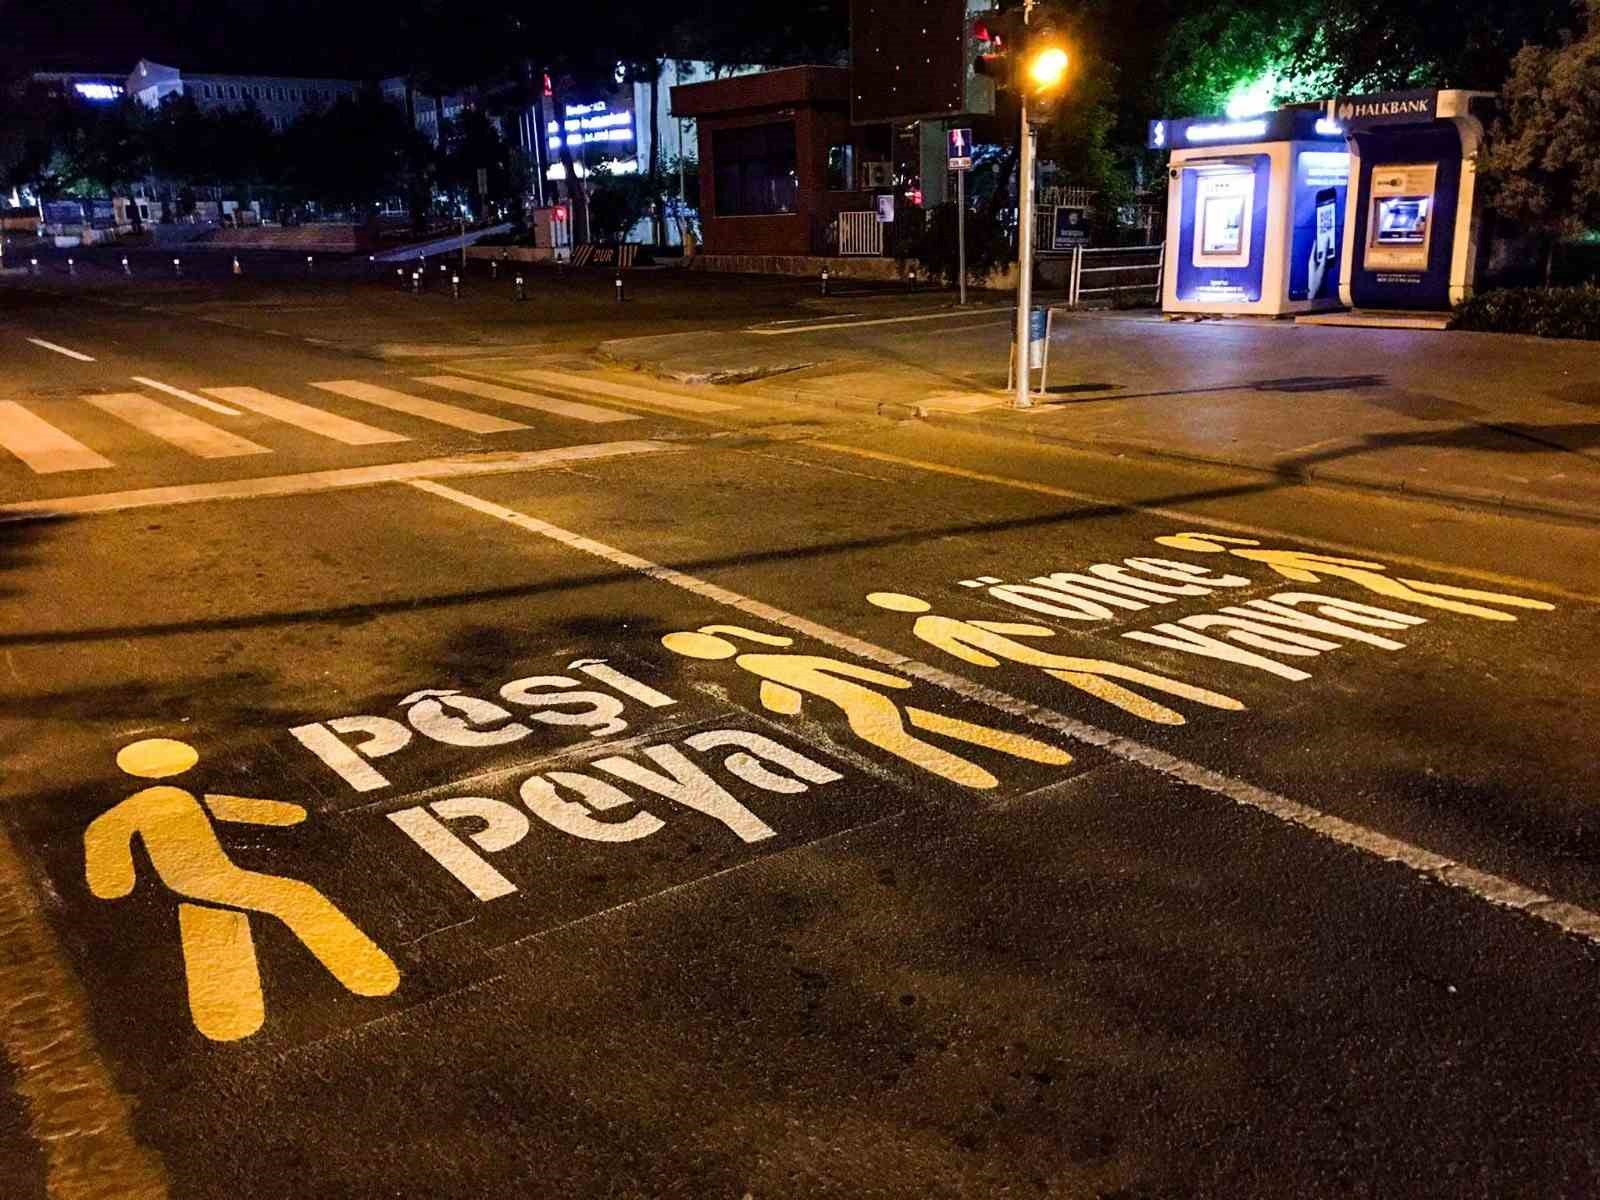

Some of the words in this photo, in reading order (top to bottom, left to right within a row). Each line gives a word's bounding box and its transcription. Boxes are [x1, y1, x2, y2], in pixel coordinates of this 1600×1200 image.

[1355, 99, 1429, 117] HALKBANK
[958, 557, 1251, 621] önce
[1121, 592, 1428, 682] yaya
[386, 729, 844, 902] peya
